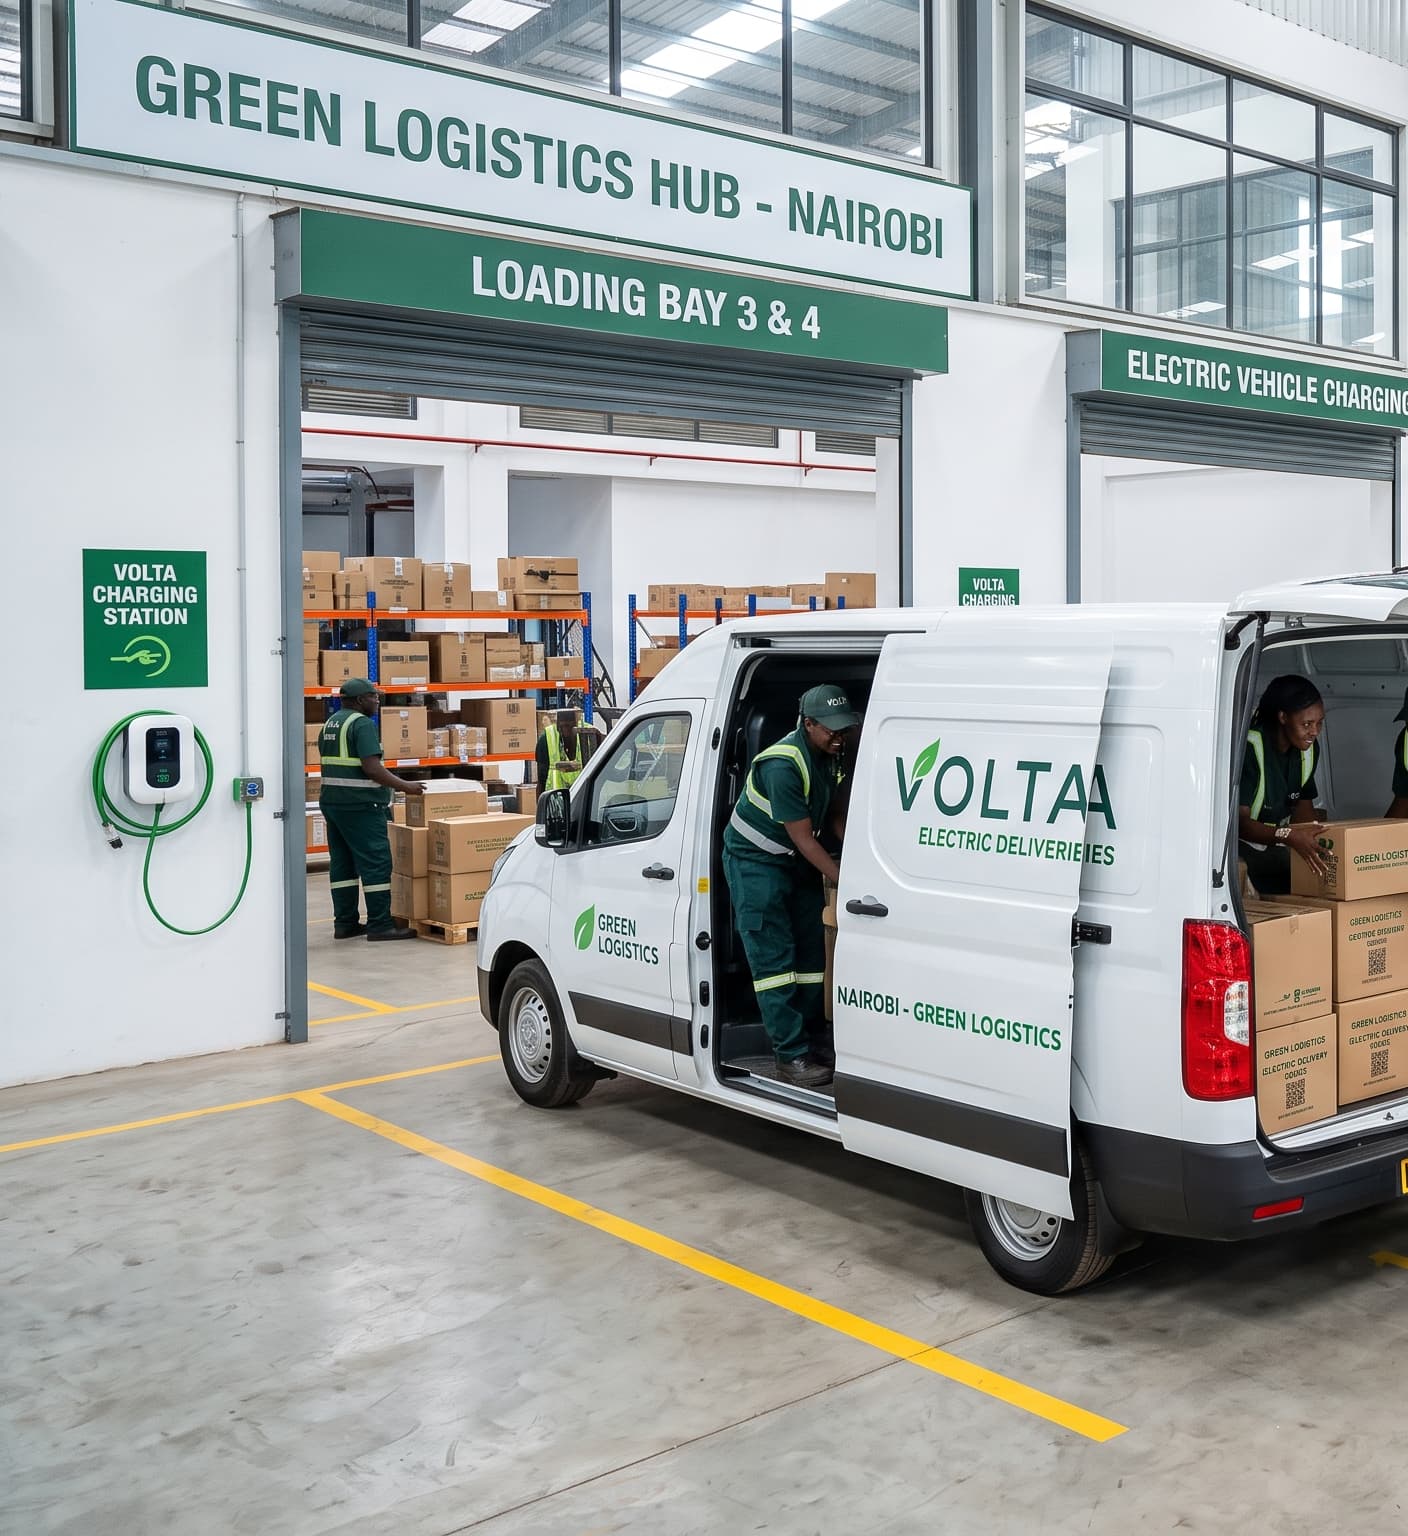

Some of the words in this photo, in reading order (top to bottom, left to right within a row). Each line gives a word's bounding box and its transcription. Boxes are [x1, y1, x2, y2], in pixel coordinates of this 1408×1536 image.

[136, 55, 342, 147] GREEN
[365, 100, 634, 200] LOGISTICS
[651, 158, 740, 220] HUB
[756, 203, 773, 213] -
[788, 187, 944, 259] NAIROBI
[472, 255, 647, 318] LOADING
[659, 282, 726, 327] BAY
[737, 297, 758, 331] 3
[767, 300, 793, 336] &
[801, 305, 821, 340] 4
[1128, 350, 1230, 393] ELECTRIC
[1237, 367, 1317, 404] VEHICLE
[114, 564, 176, 581] VOLTA
[973, 578, 1005, 591] VOLTA
[93, 586, 197, 603] CHARGING
[962, 594, 1016, 606] CHARGING
[104, 608, 187, 625] STATION
[918, 827, 992, 852] ELECTRIC
[1353, 853, 1380, 865] GREEN
[598, 913, 636, 937] GREEN
[598, 936, 659, 965] LOGISTICS
[837, 986, 899, 1016] NAIROBI
[913, 1002, 966, 1031] GREEN
[971, 1015, 1061, 1051] LOGISTICS
